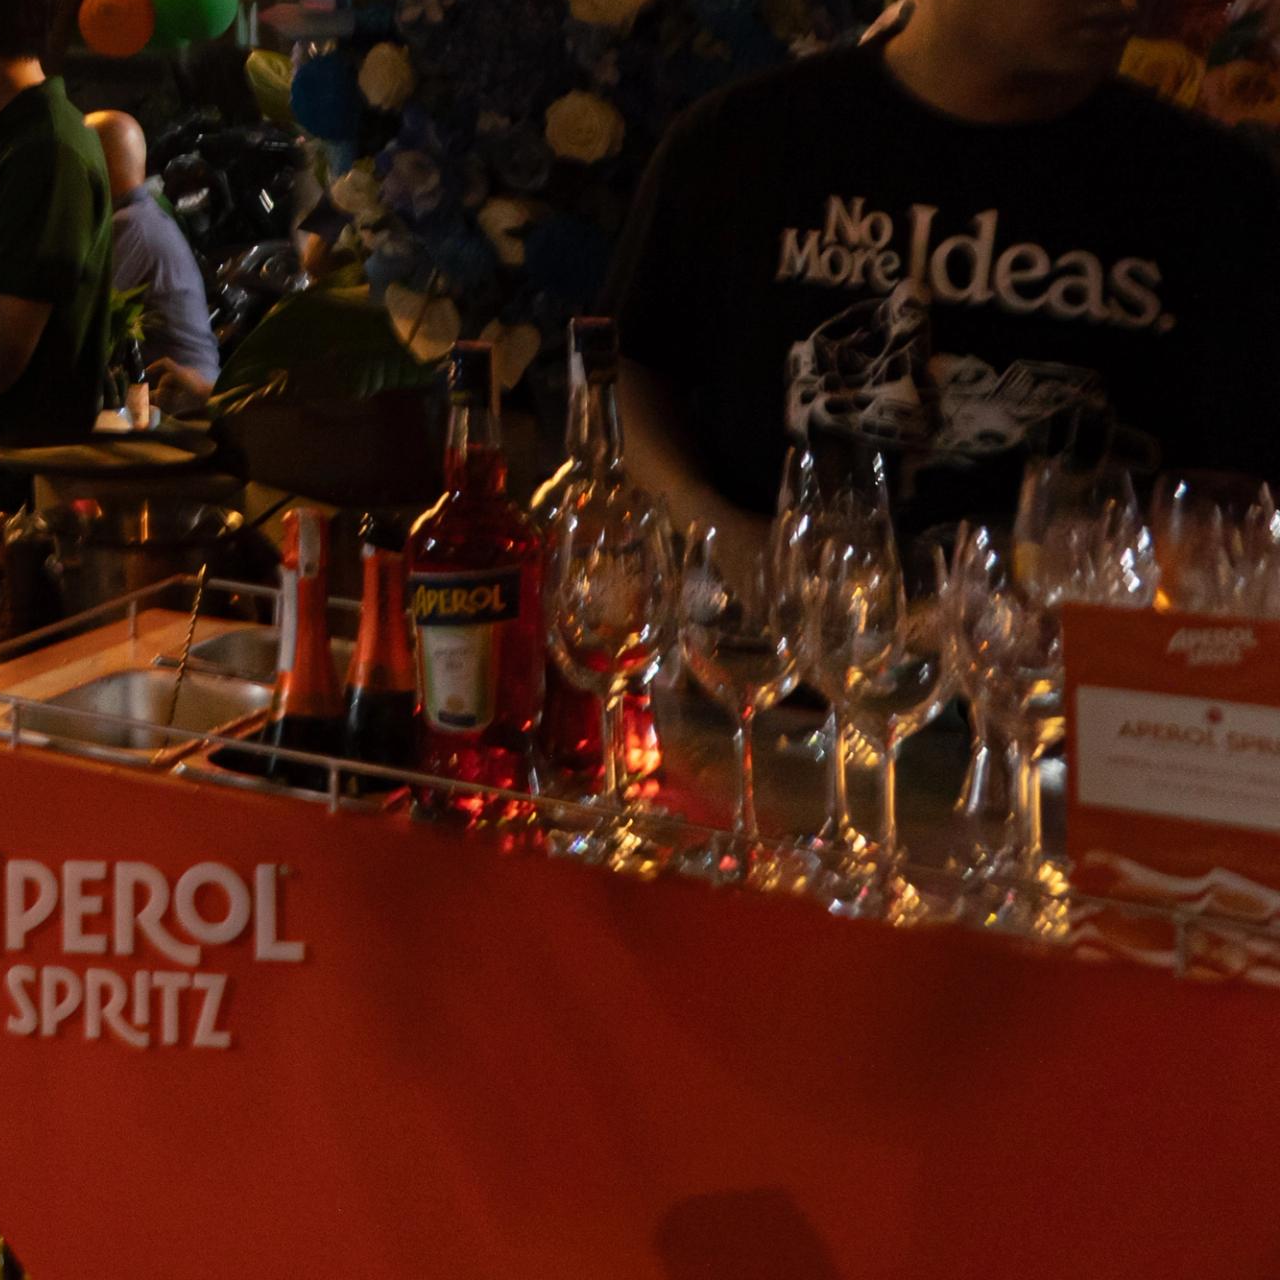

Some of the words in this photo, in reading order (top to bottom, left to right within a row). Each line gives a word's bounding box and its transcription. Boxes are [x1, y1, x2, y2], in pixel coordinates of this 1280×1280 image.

[822, 194, 895, 250] No
[774, 226, 902, 292] More
[414, 584, 507, 616] APEROL
[5, 964, 232, 1050] SPRITZ
